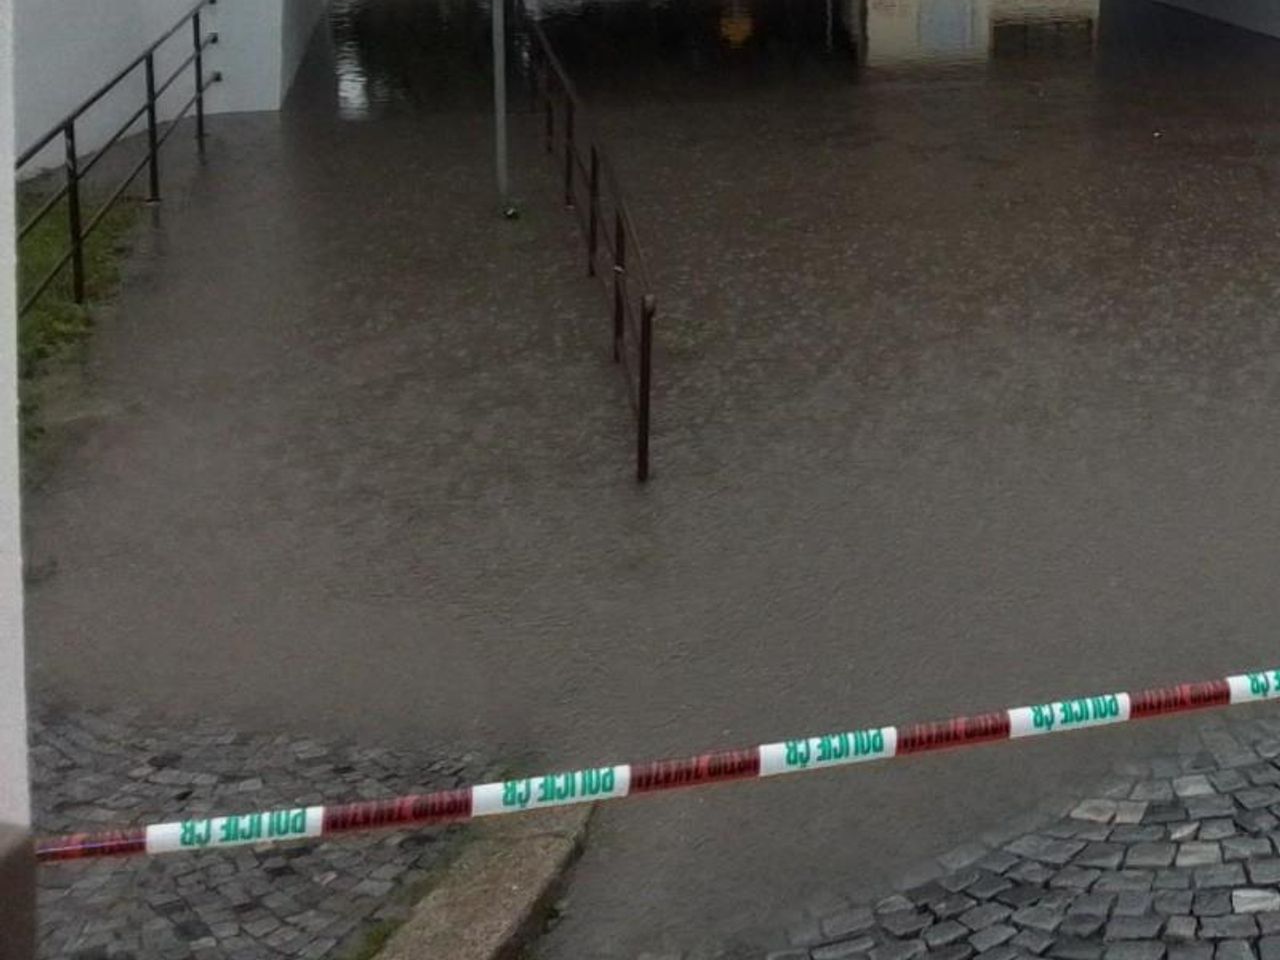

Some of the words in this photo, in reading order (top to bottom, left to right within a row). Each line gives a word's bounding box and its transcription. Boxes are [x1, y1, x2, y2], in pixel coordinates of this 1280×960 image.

[1060, 693, 1120, 725] POLICIE
[817, 728, 885, 762] POLICIE
[537, 765, 616, 803] POLICIE
